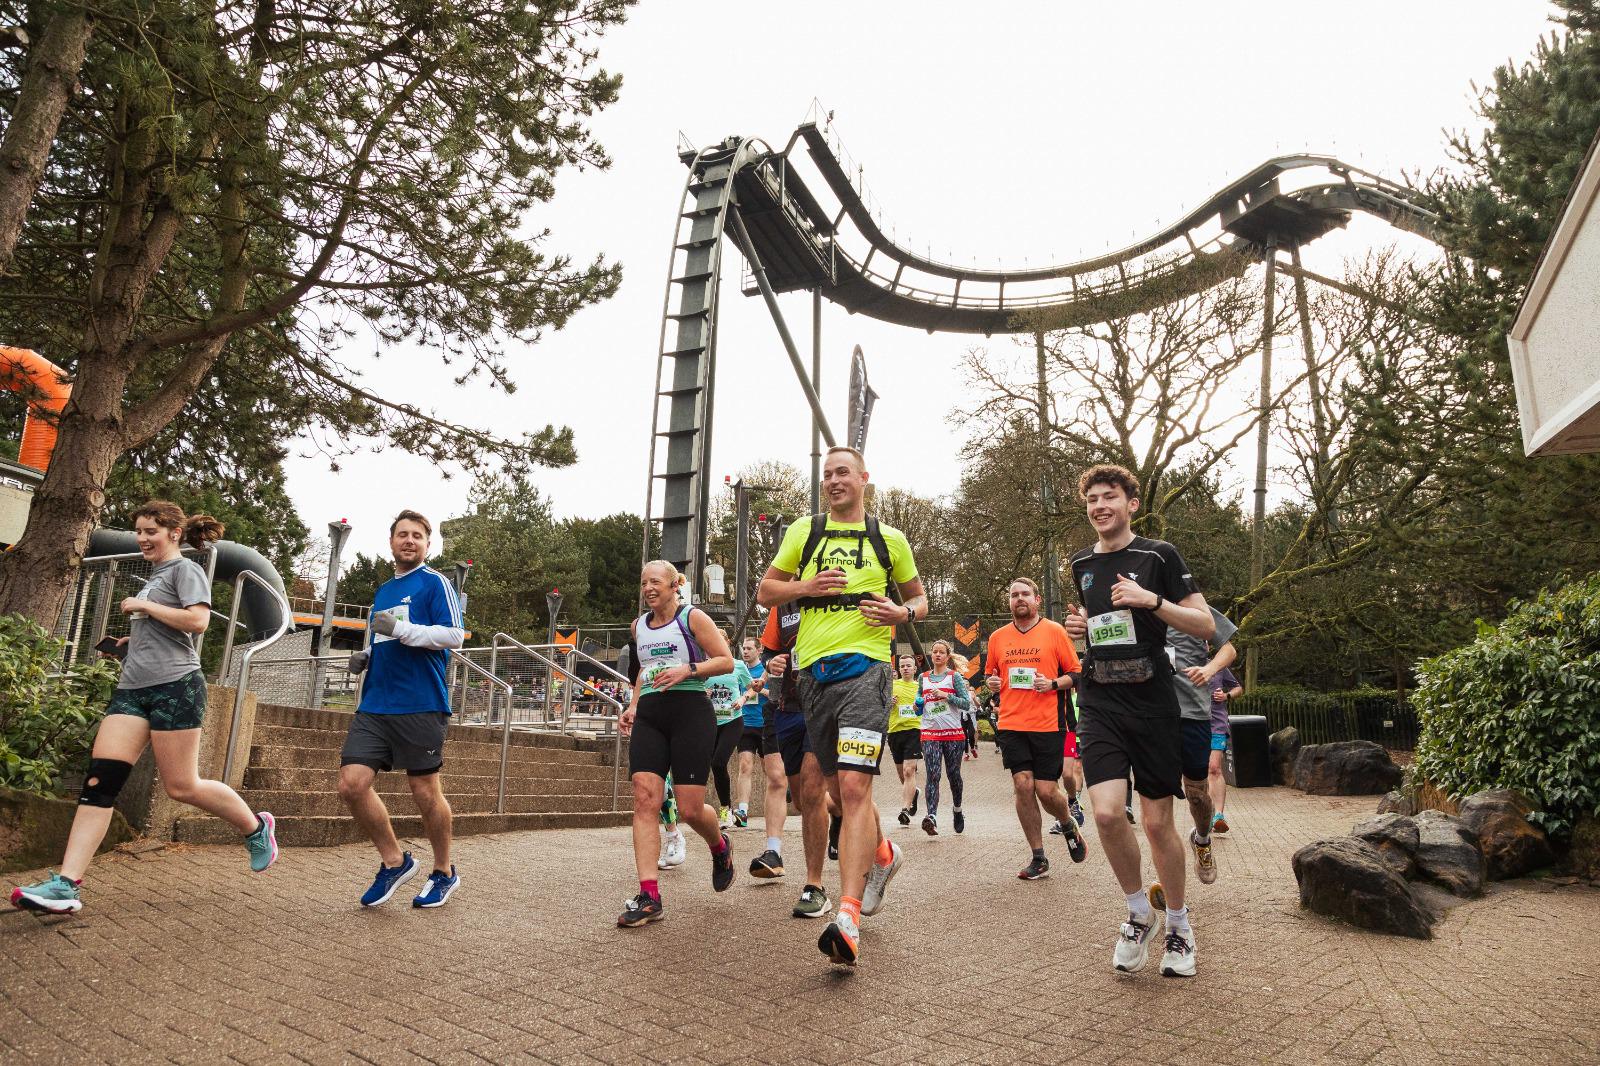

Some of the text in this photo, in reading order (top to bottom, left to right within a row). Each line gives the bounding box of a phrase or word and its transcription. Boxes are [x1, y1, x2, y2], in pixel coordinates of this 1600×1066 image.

[1095, 626, 1123, 641] 1915
[639, 641, 670, 651] ymphoma
[1005, 647, 1041, 658] SMALLEY
[1013, 674, 1029, 683] 764
